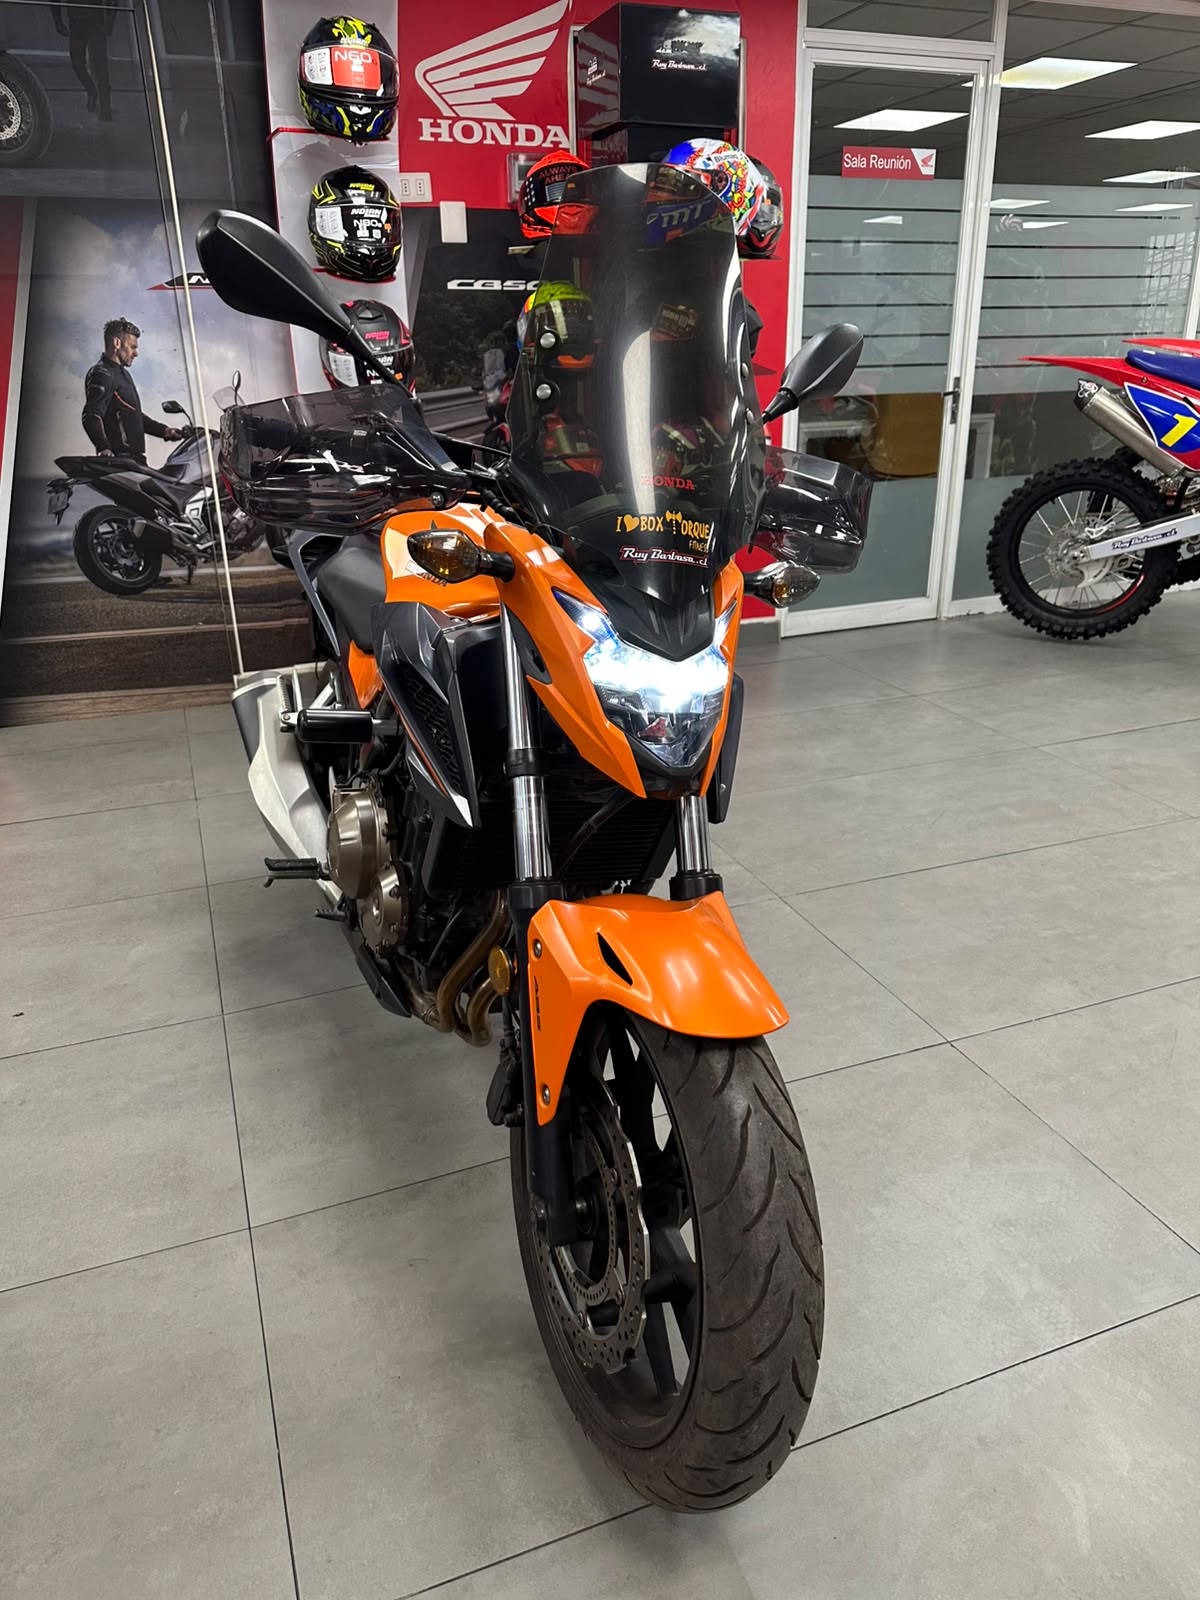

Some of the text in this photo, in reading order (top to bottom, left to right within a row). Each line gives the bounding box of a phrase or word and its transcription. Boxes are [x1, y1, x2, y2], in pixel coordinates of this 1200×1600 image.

[418, 117, 570, 149] HONDA
[843, 153, 911, 170] Sala Reunión
[539, 166, 578, 178] ALWAYS
[1160, 413, 1198, 447] 1
[641, 476, 696, 491] HONDA
[615, 516, 623, 532] I
[640, 516, 664, 532] BOX
[622, 547, 648, 561] Ruy
